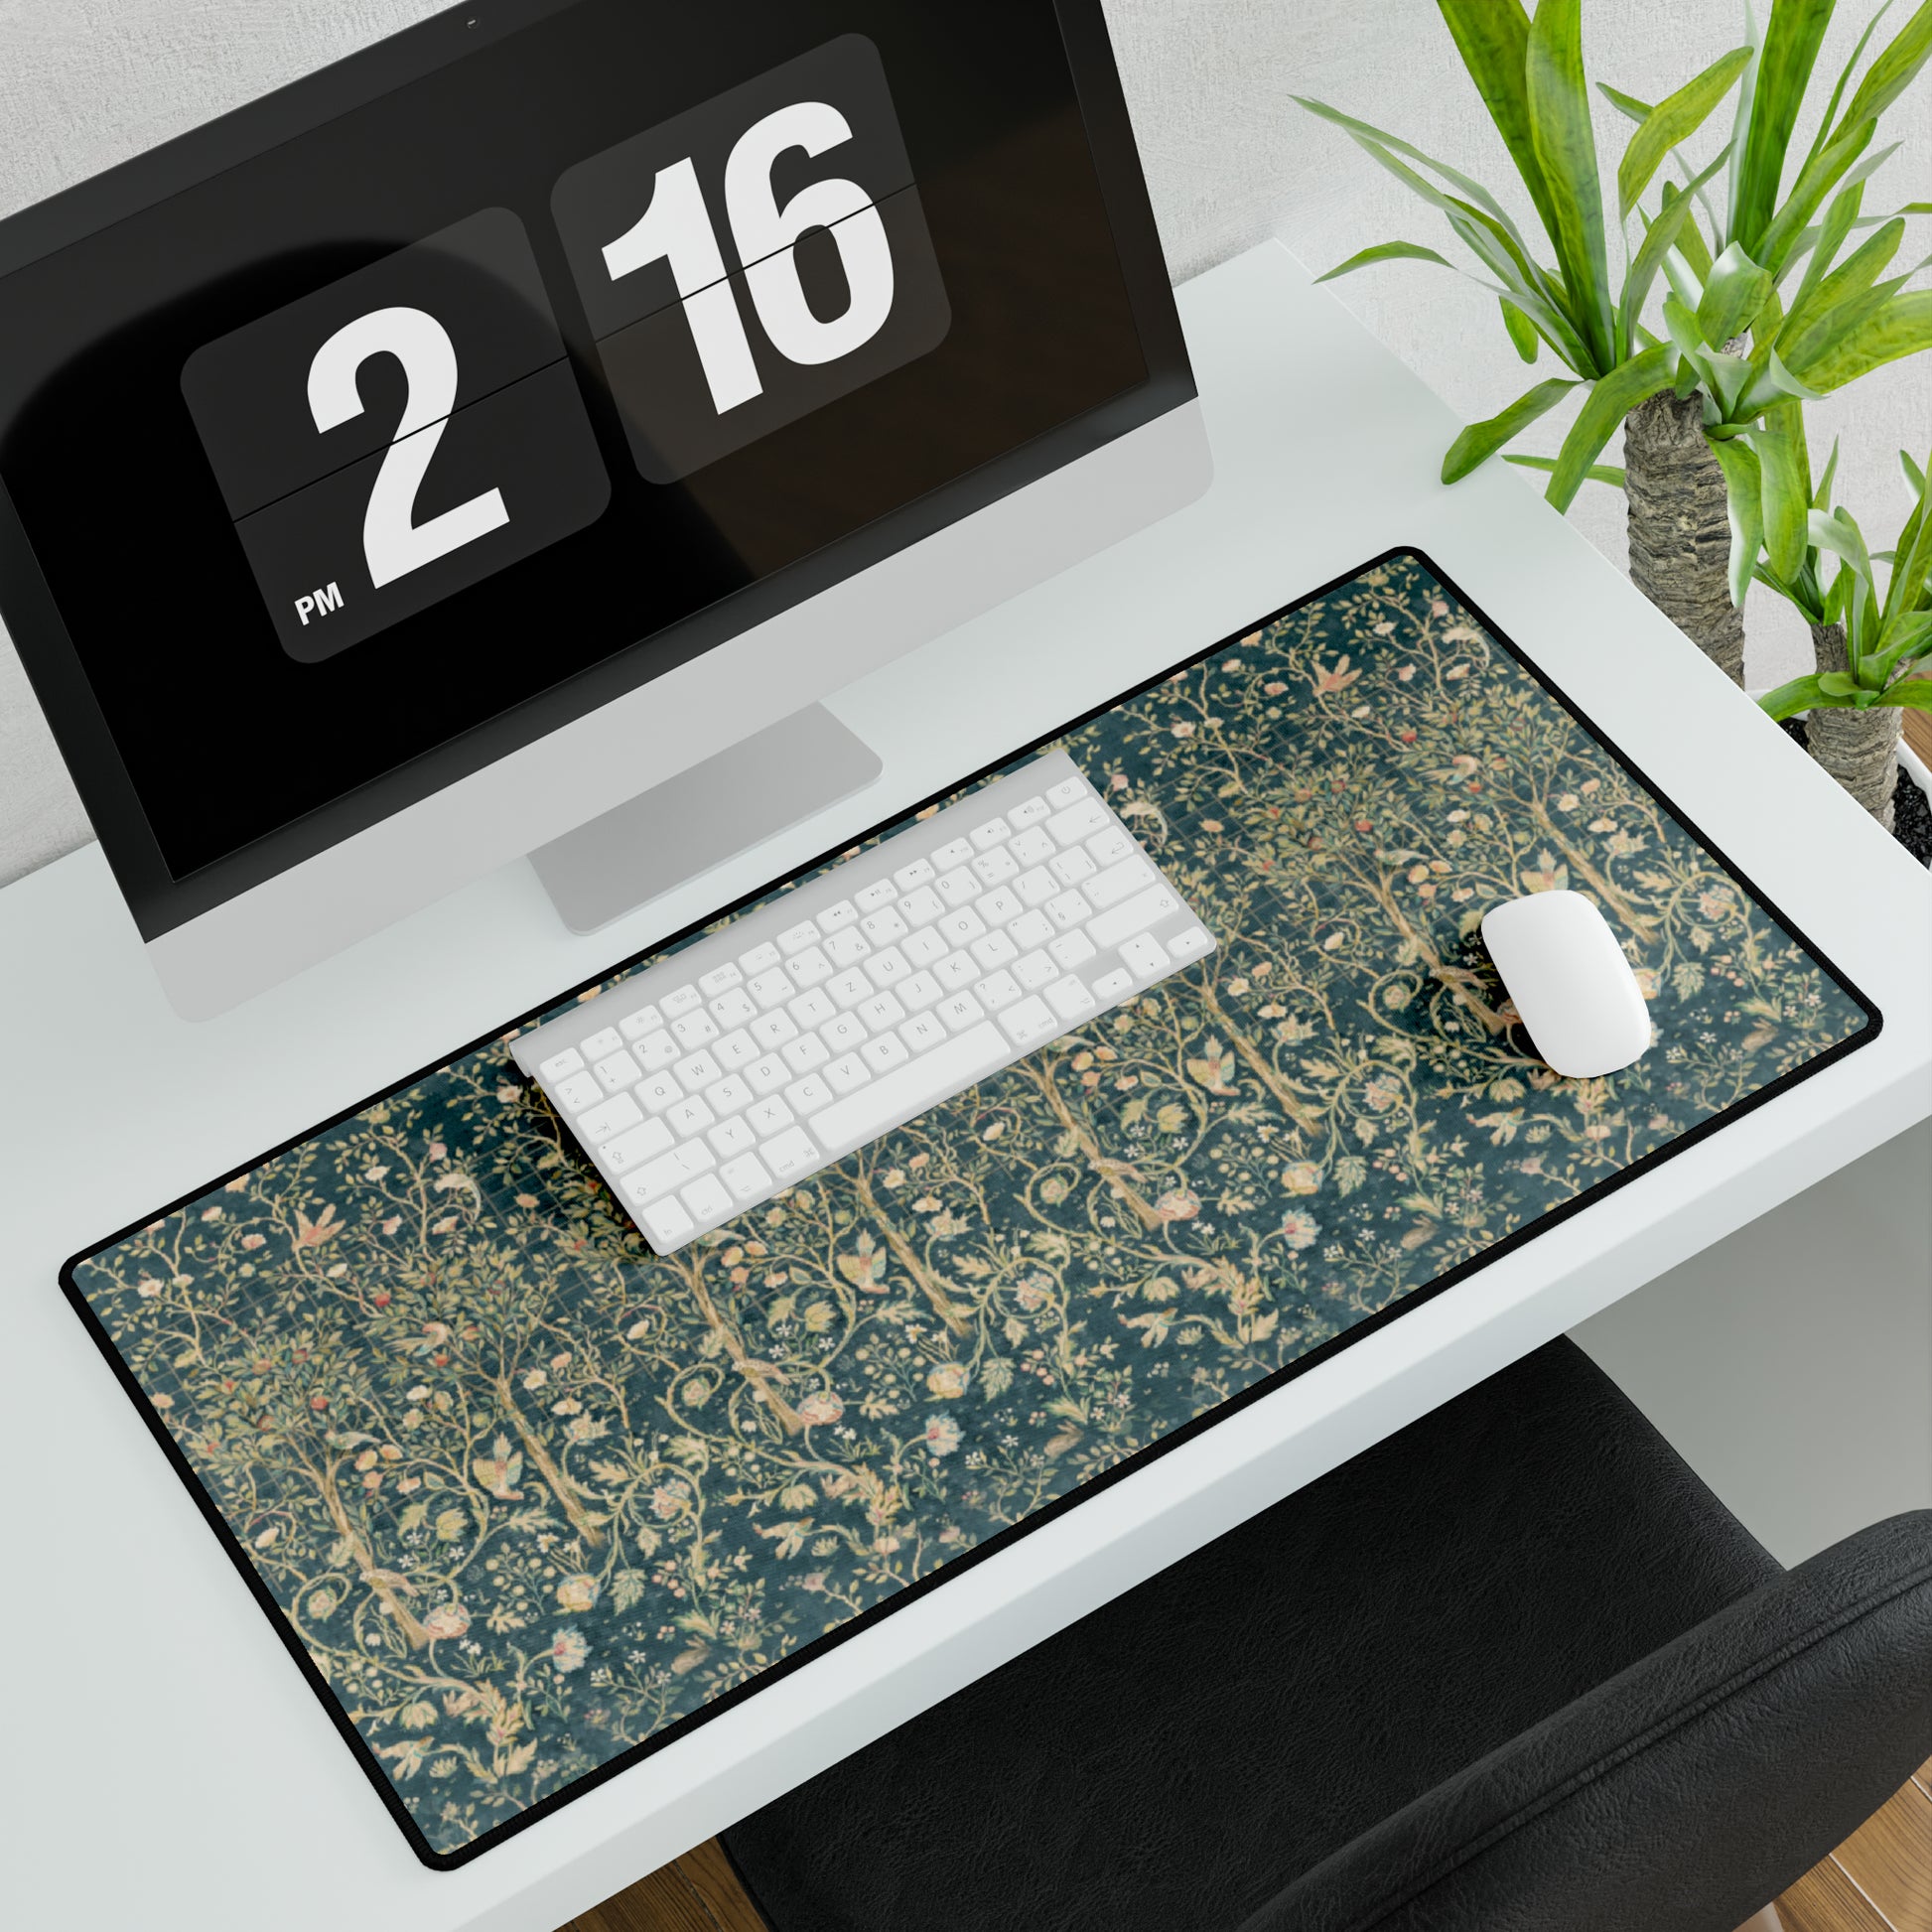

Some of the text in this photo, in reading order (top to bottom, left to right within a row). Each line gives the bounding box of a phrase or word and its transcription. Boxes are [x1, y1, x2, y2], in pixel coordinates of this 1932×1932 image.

[306, 101, 895, 590] 2 16
[294, 581, 345, 626] PM
[599, 880, 951, 1075] 1 2 3 4 5 6 7 8 9 0
[653, 1085, 667, 1097] Q
[690, 1063, 707, 1077] W
[731, 1043, 742, 1055] E
[769, 1024, 781, 1034] R
[807, 1002, 818, 1013] T
[844, 981, 857, 993] Z
[882, 960, 895, 972] U
[957, 920, 969, 931] O
[994, 899, 1005, 911] P
[684, 1108, 696, 1120] A
[722, 1087, 733, 1098] S
[759, 1065, 771, 1077] D
[798, 1044, 808, 1055] F
[836, 1024, 848, 1035] G
[874, 1003, 887, 1016] H
[949, 961, 962, 973] K
[987, 942, 999, 952] L
[724, 1002, 968, 1140] Y X C V B N M
